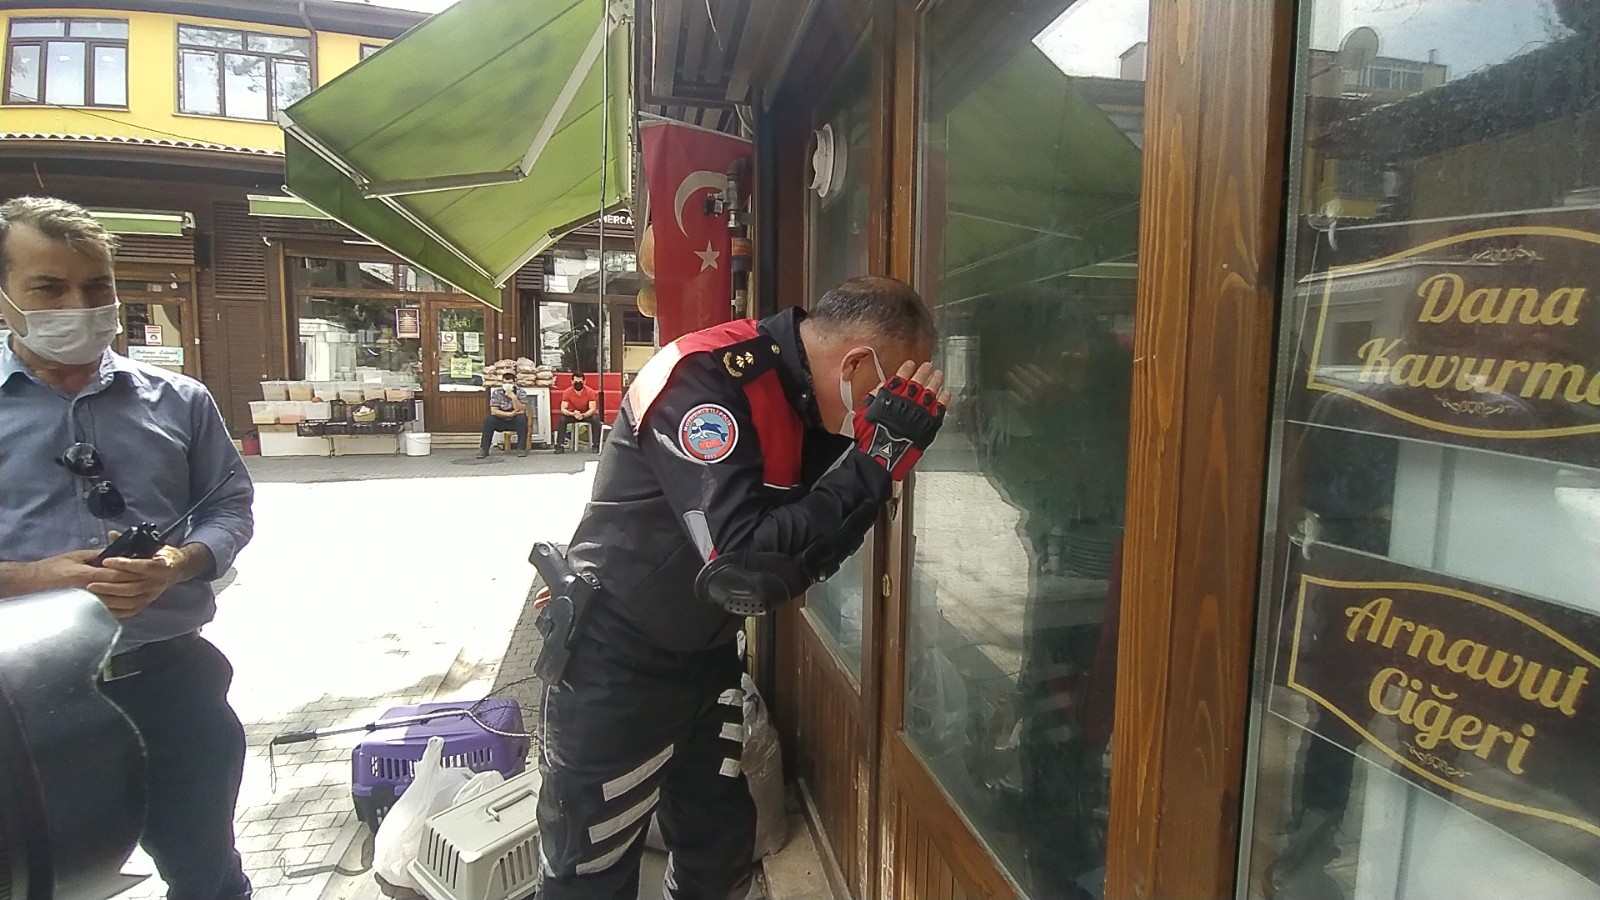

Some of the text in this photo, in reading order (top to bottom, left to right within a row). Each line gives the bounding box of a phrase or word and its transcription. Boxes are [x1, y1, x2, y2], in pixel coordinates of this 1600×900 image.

[1417, 272, 1586, 326] Dana
[1345, 597, 1589, 716] Arnavut
[1368, 667, 1536, 775] Ciğeri
